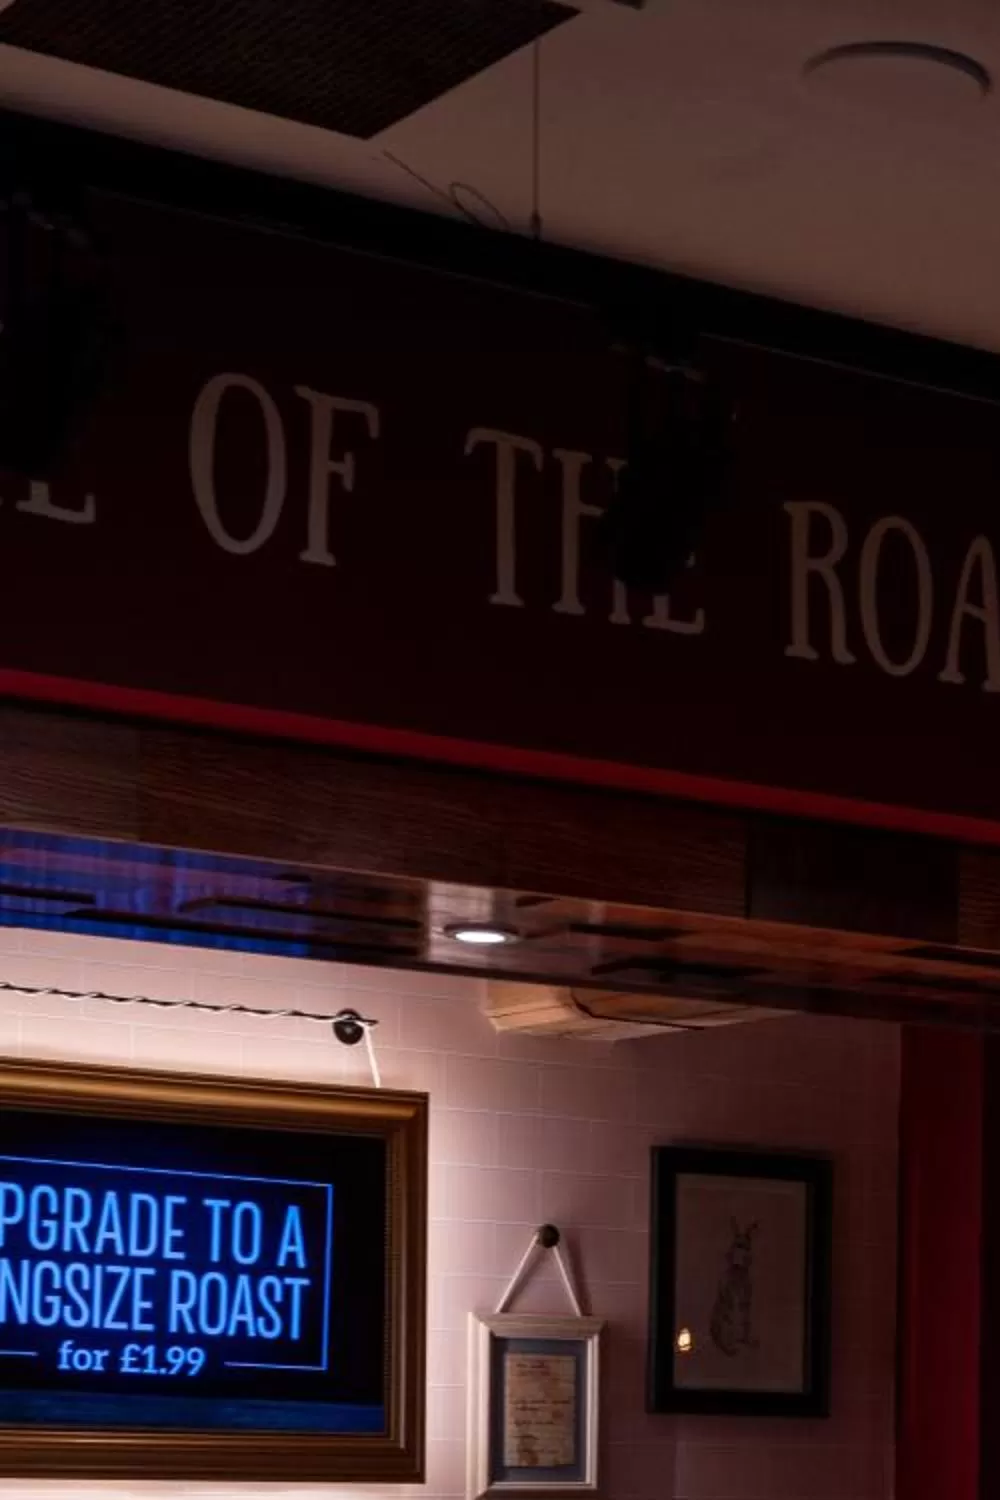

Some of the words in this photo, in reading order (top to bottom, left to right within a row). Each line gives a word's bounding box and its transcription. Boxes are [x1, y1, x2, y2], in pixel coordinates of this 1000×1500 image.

[187, 370, 382, 568] OF
[462, 424, 706, 637] TH
[0, 1180, 190, 1261] PGRADE
[202, 1198, 263, 1266] TO
[276, 1203, 307, 1269] A
[0, 1257, 156, 1332] NGSIZE
[167, 1268, 312, 1341] ROAST
[56, 1339, 110, 1372] for
[118, 1343, 207, 1377] £1.99
